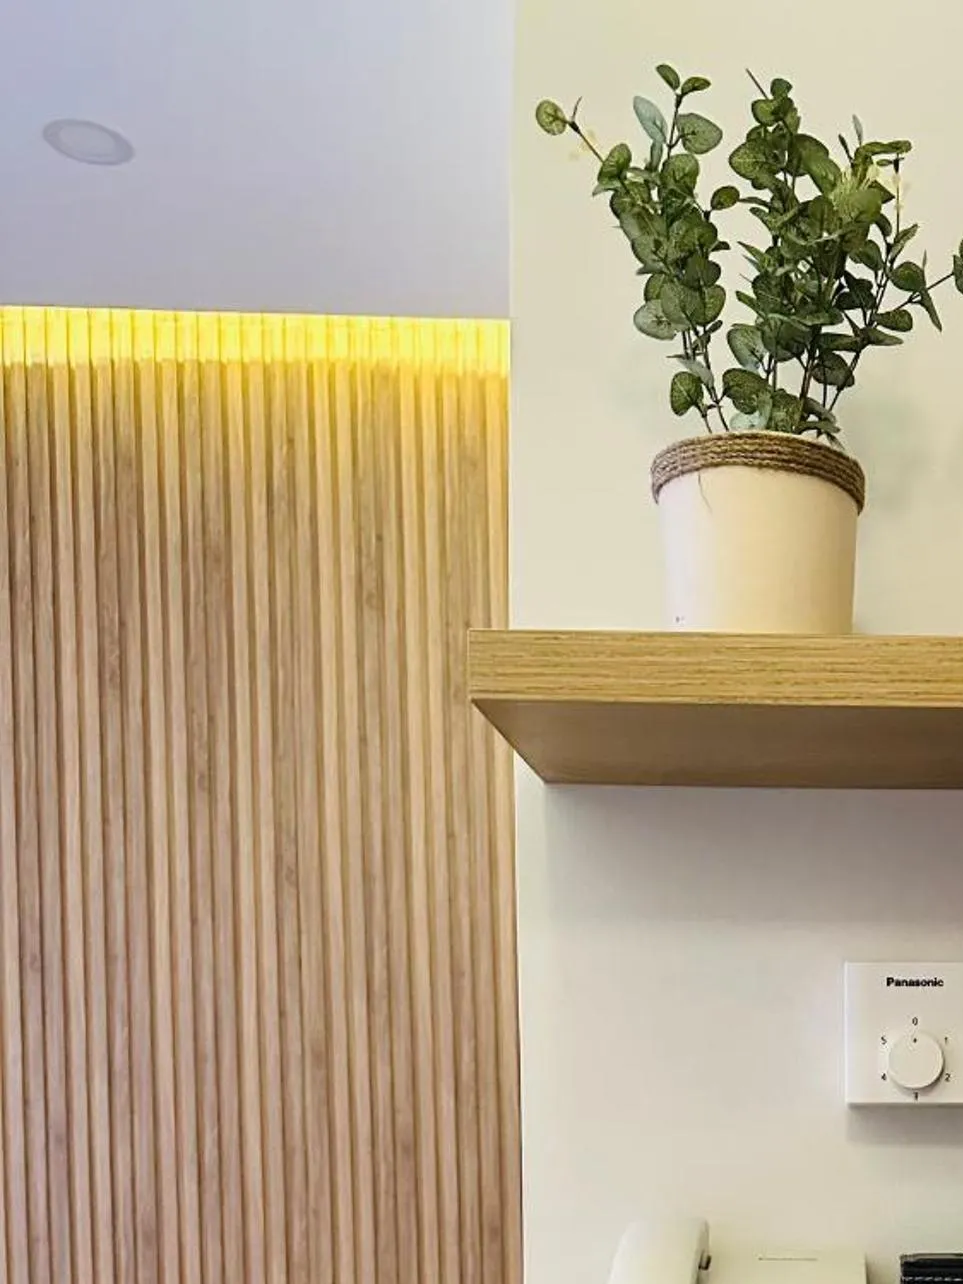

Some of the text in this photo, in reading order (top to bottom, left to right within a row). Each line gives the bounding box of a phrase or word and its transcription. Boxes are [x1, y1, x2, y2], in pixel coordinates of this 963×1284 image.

[886, 977, 944, 987] Panasonic
[911, 1016, 919, 1026] 0
[880, 1036, 888, 1045] 5
[944, 1073, 951, 1082] 2
